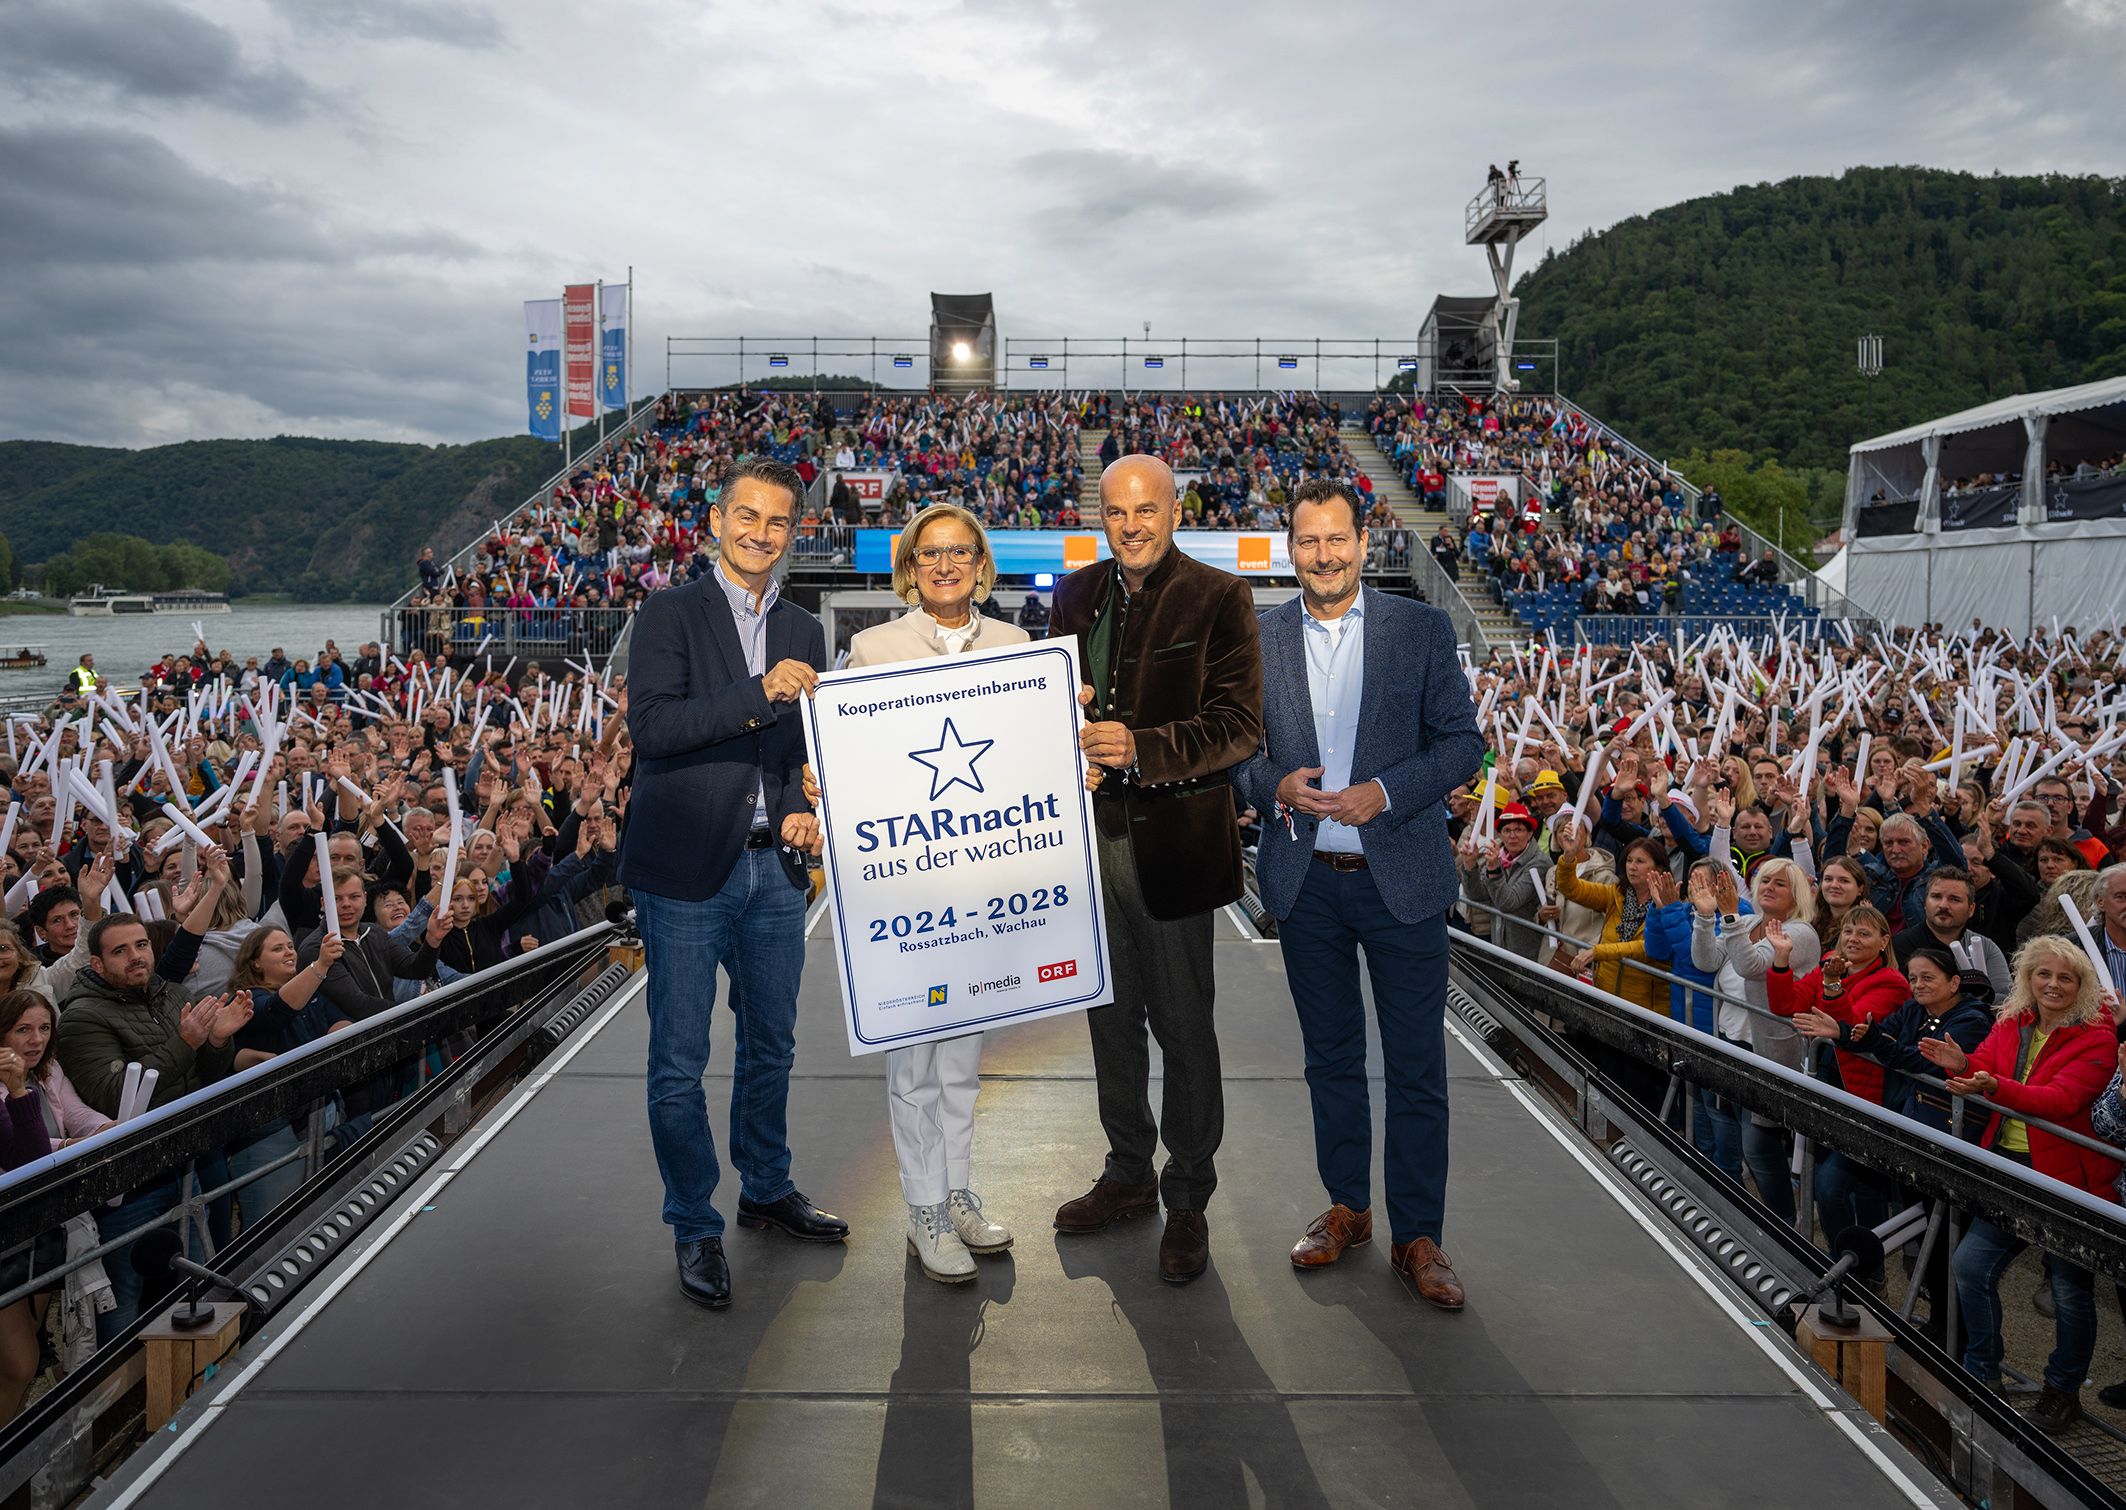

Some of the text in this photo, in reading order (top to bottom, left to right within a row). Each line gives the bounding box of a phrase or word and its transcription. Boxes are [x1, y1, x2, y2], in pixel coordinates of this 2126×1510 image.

[1239, 560, 1268, 569] event
[837, 674, 1047, 717] Kooperationsvereinbarung
[855, 793, 1060, 852] STARnacht
[863, 828, 1064, 881] aus der wachau
[869, 906, 957, 942] 2024
[987, 884, 1069, 920] 2028
[900, 917, 1046, 953] Rossatzbach, Wachau
[1041, 963, 1074, 979] ORF
